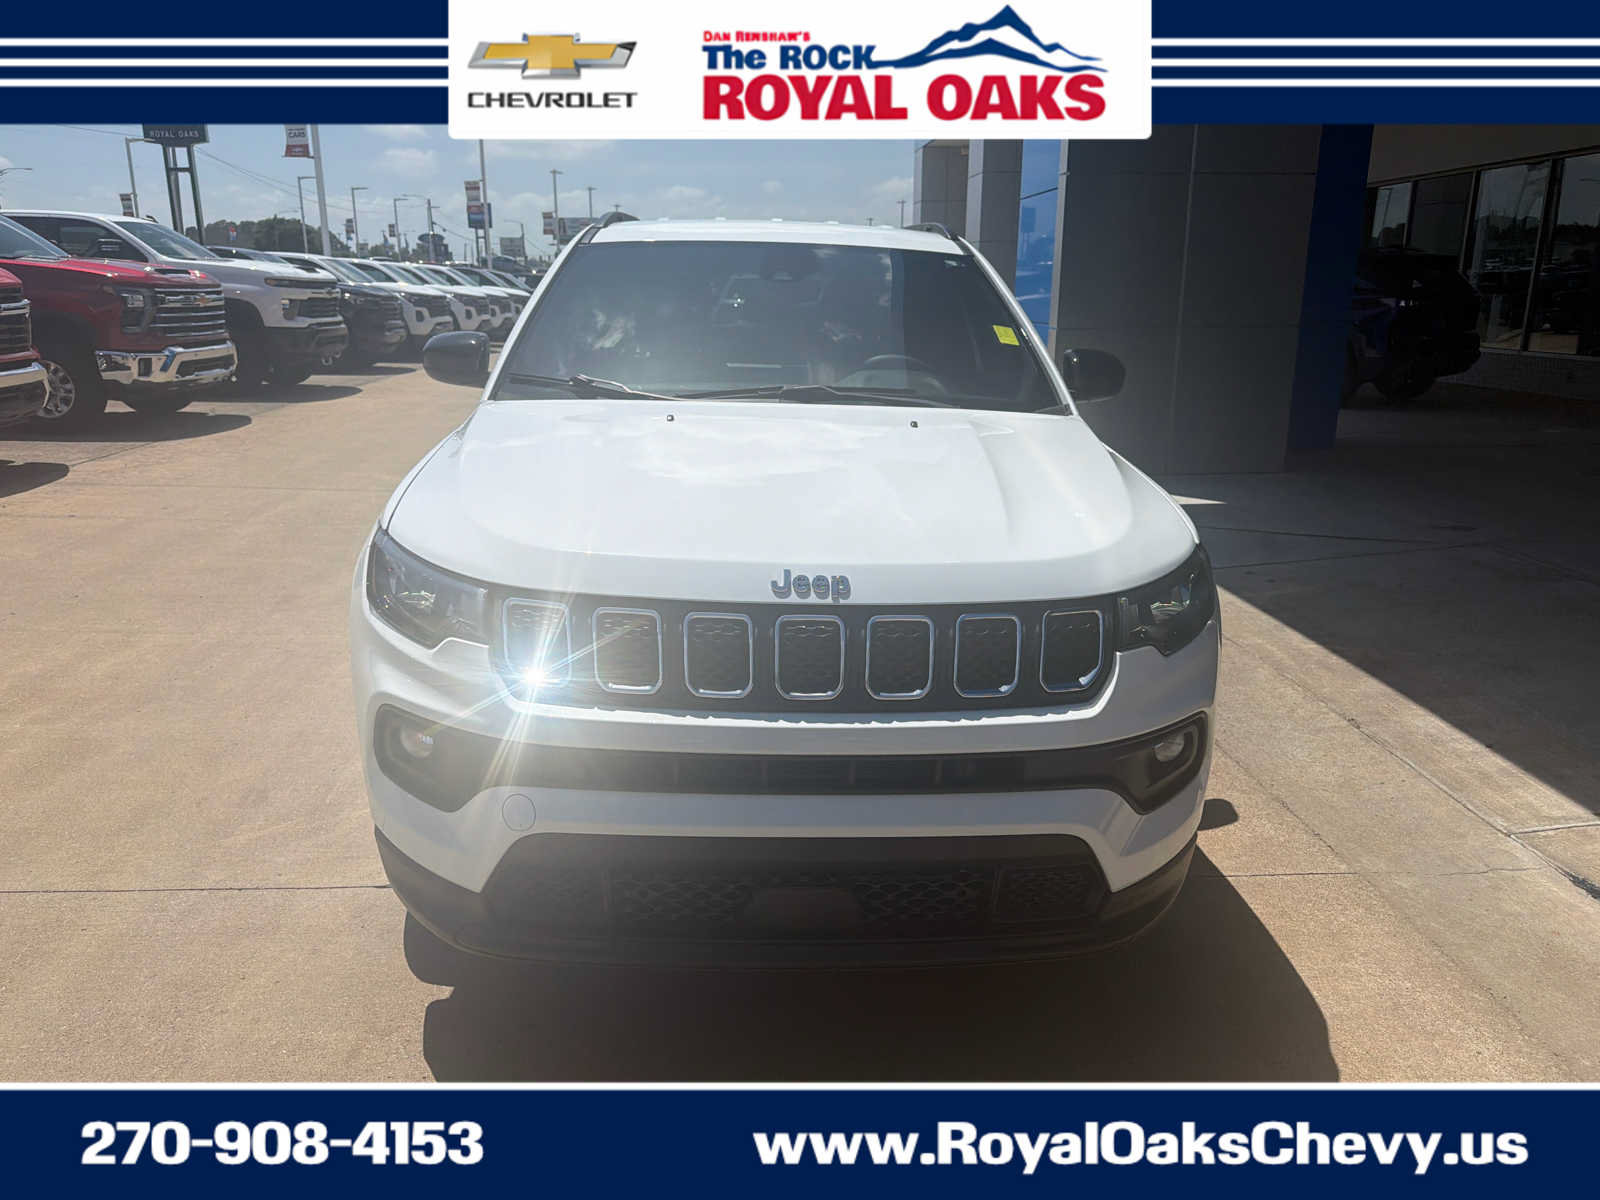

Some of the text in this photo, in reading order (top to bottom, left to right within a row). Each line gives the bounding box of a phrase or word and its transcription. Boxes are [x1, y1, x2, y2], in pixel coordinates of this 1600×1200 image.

[150, 129, 200, 138] ROYAL OAKS
[770, 568, 851, 604] Jeep
